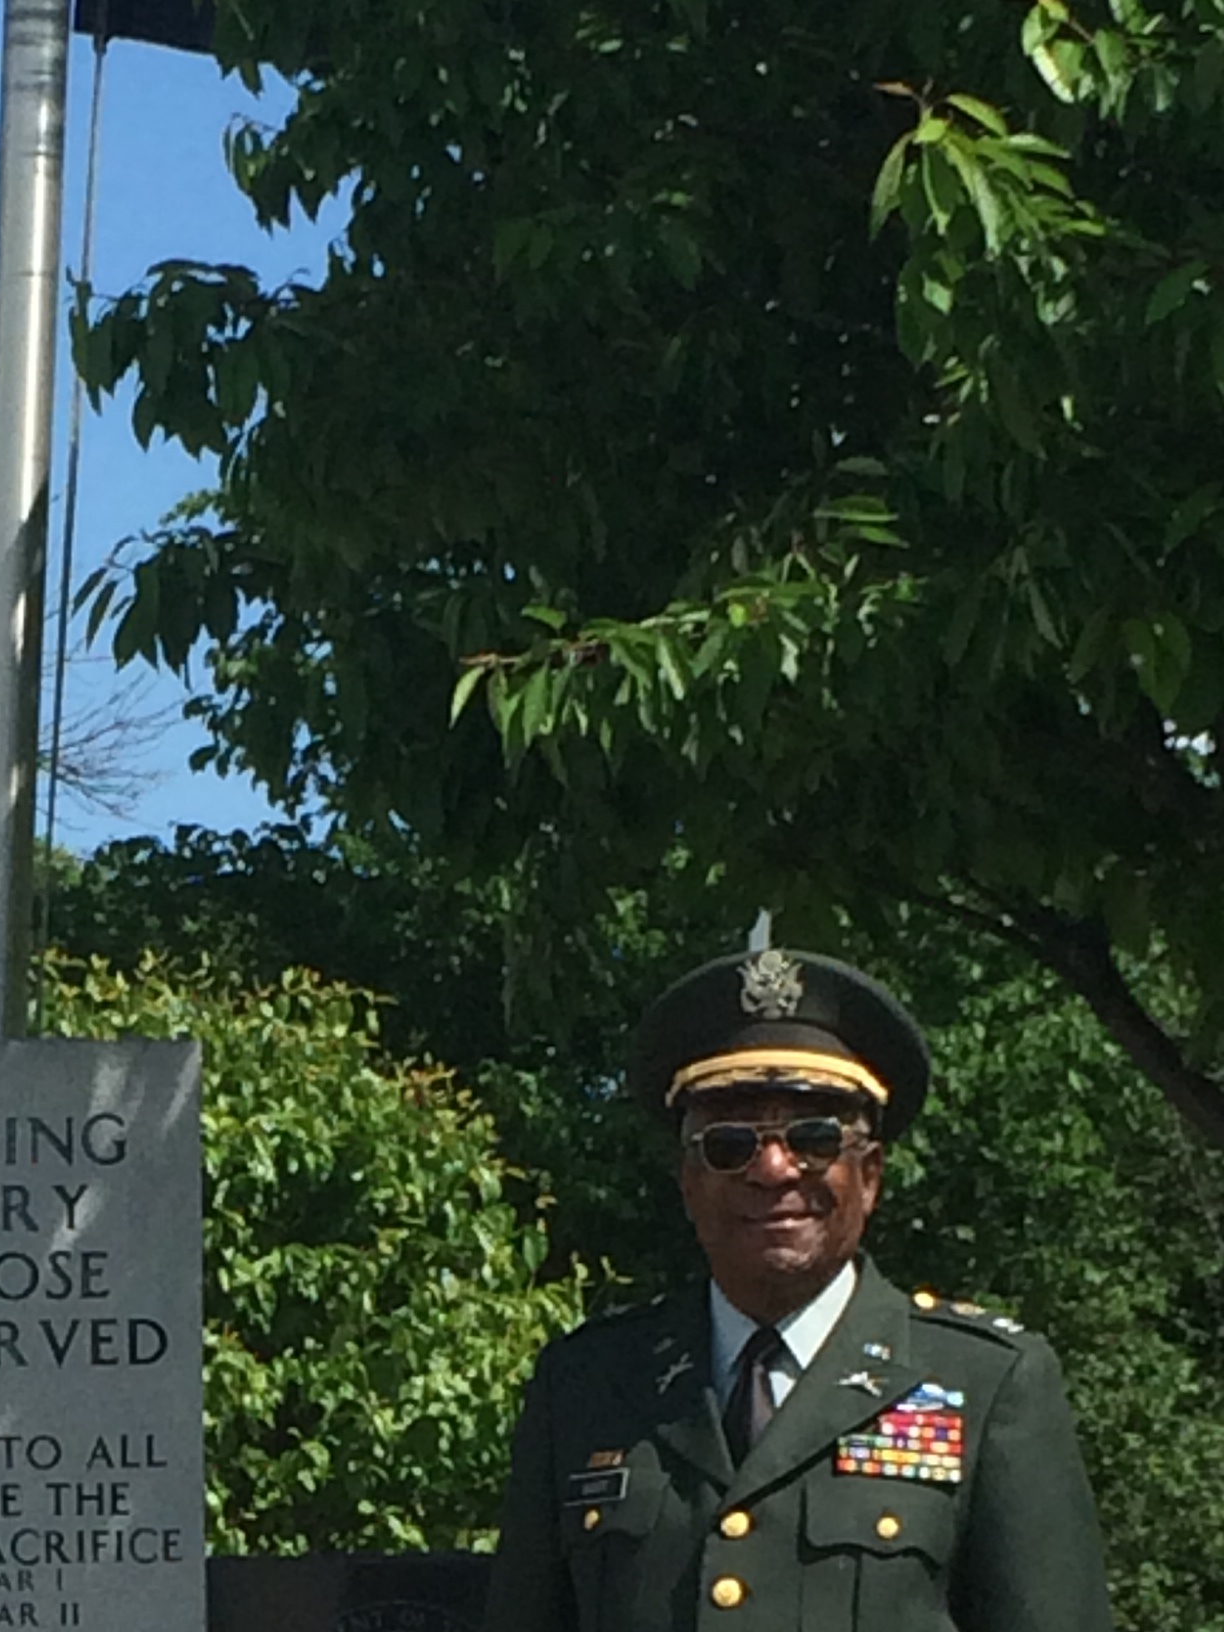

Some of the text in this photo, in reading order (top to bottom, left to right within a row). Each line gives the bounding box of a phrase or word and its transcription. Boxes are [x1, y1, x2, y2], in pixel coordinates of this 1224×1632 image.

[86, 1434, 167, 1470] ALL
[45, 1482, 129, 1516] THE
[56, 1568, 62, 1591] I
[61, 1603, 79, 1626] II
